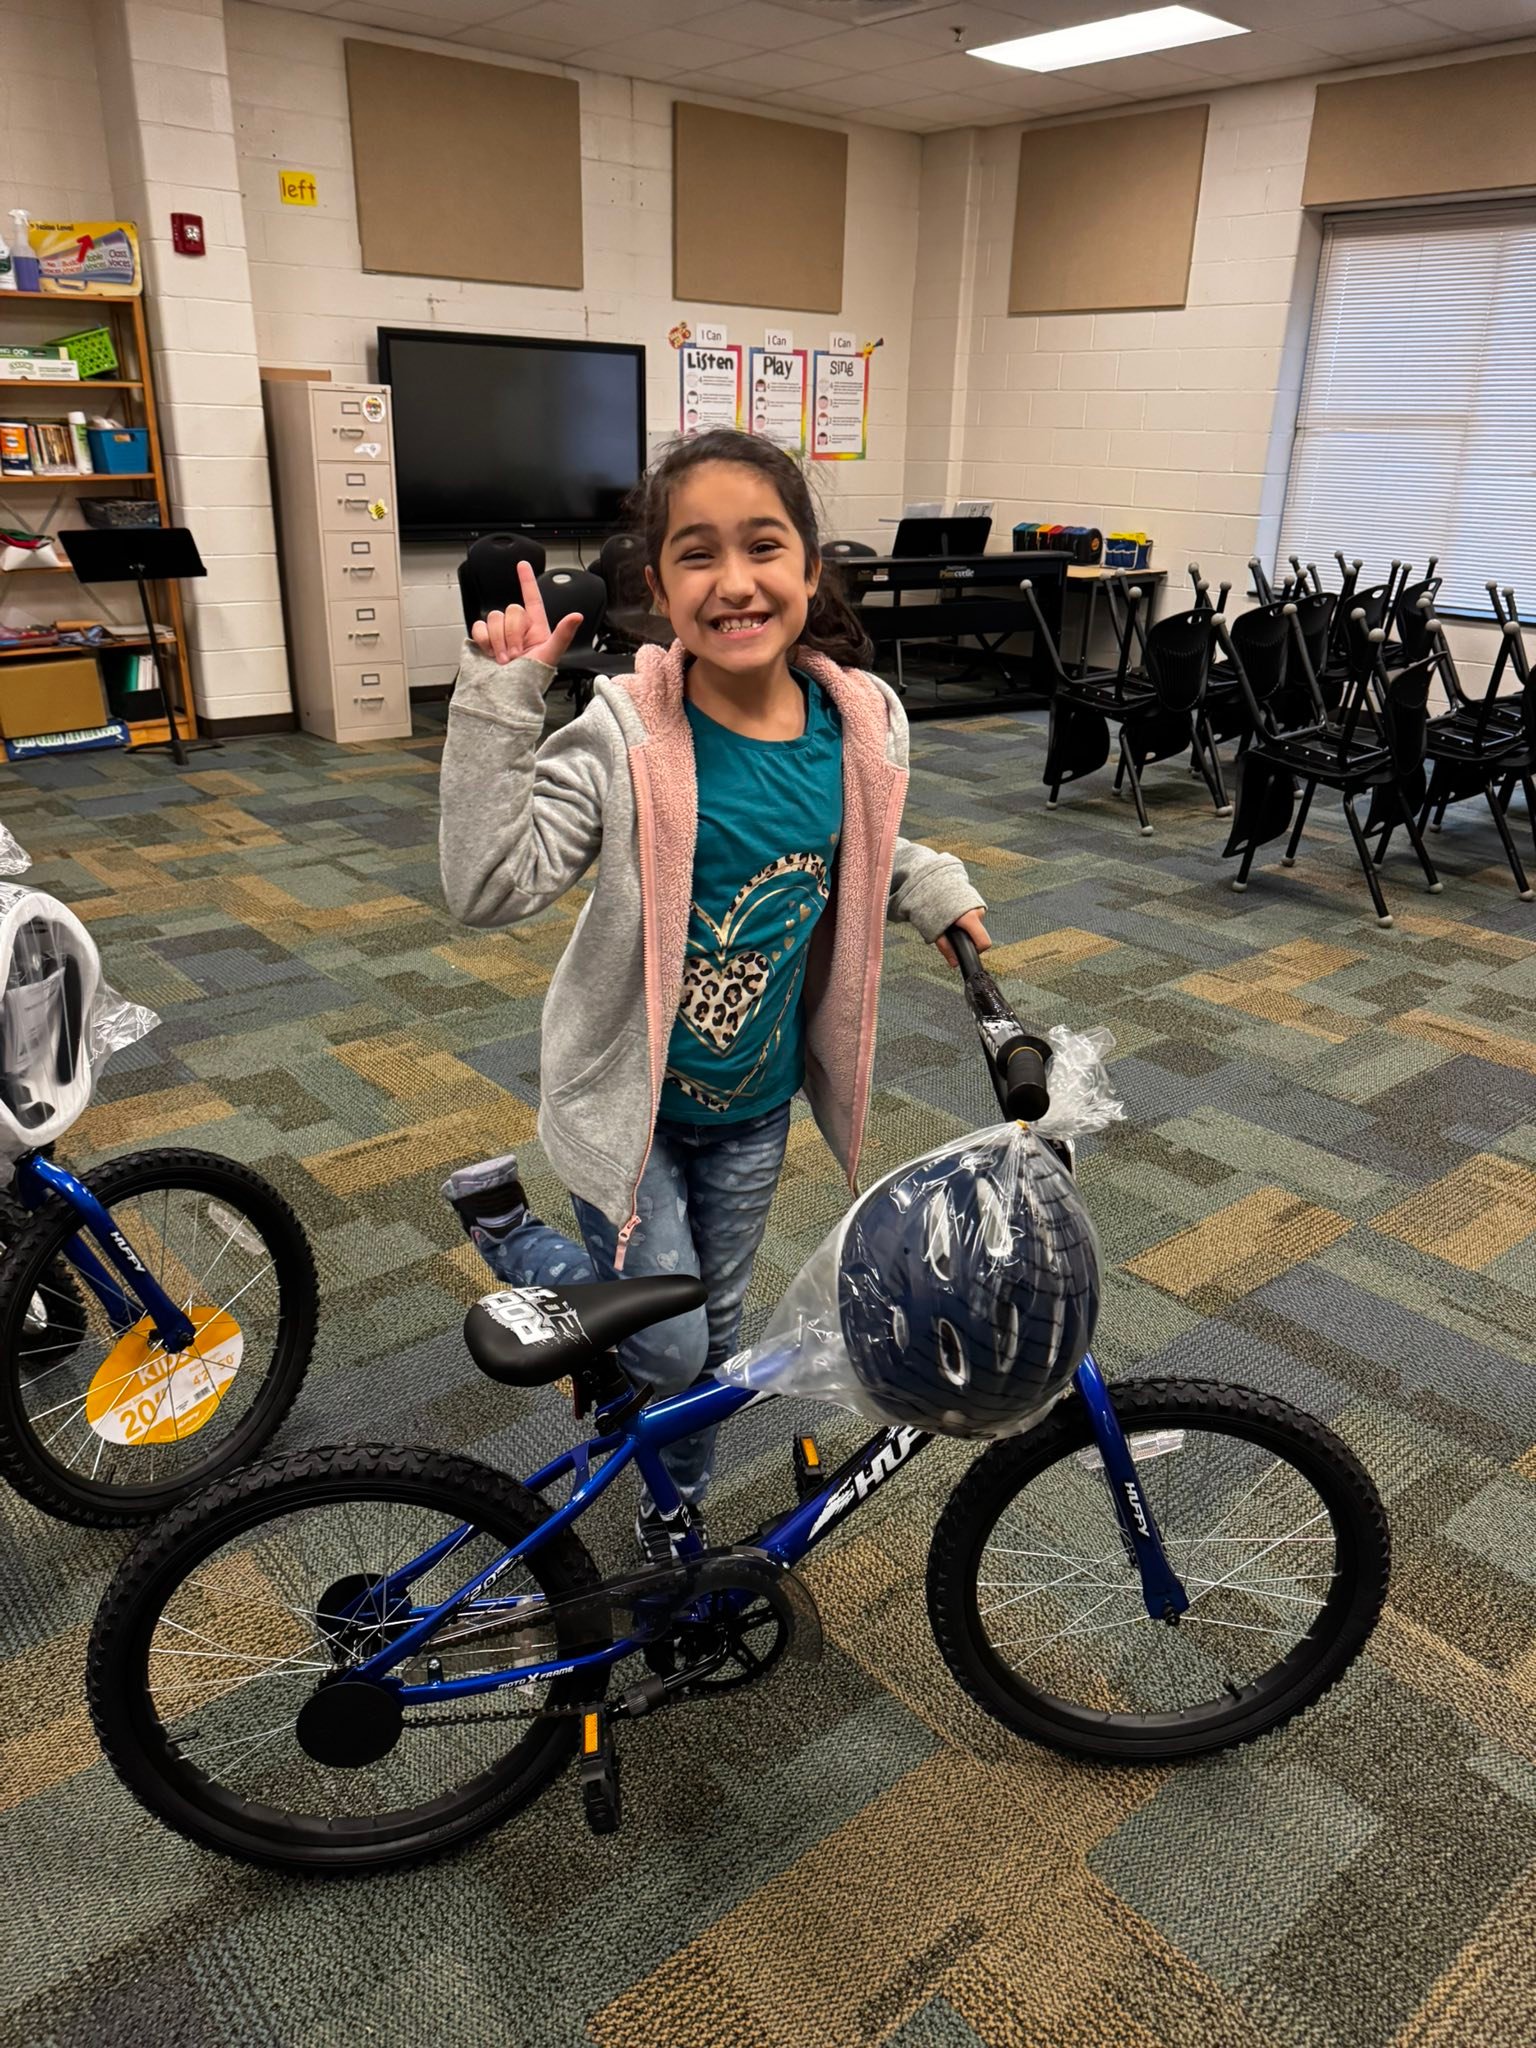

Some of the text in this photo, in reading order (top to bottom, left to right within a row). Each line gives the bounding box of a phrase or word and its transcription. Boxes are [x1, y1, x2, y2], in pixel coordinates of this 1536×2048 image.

[281, 176, 317, 200] left
[706, 329, 722, 342] Can
[772, 335, 787, 346] Can
[837, 336, 852, 348] Can
[687, 351, 734, 371] Listen
[763, 355, 793, 380] Play
[110, 1231, 146, 1272] HUFFY
[1124, 1482, 1151, 1537] HUFFY
[498, 1665, 575, 1690] MOTO X FRAME
